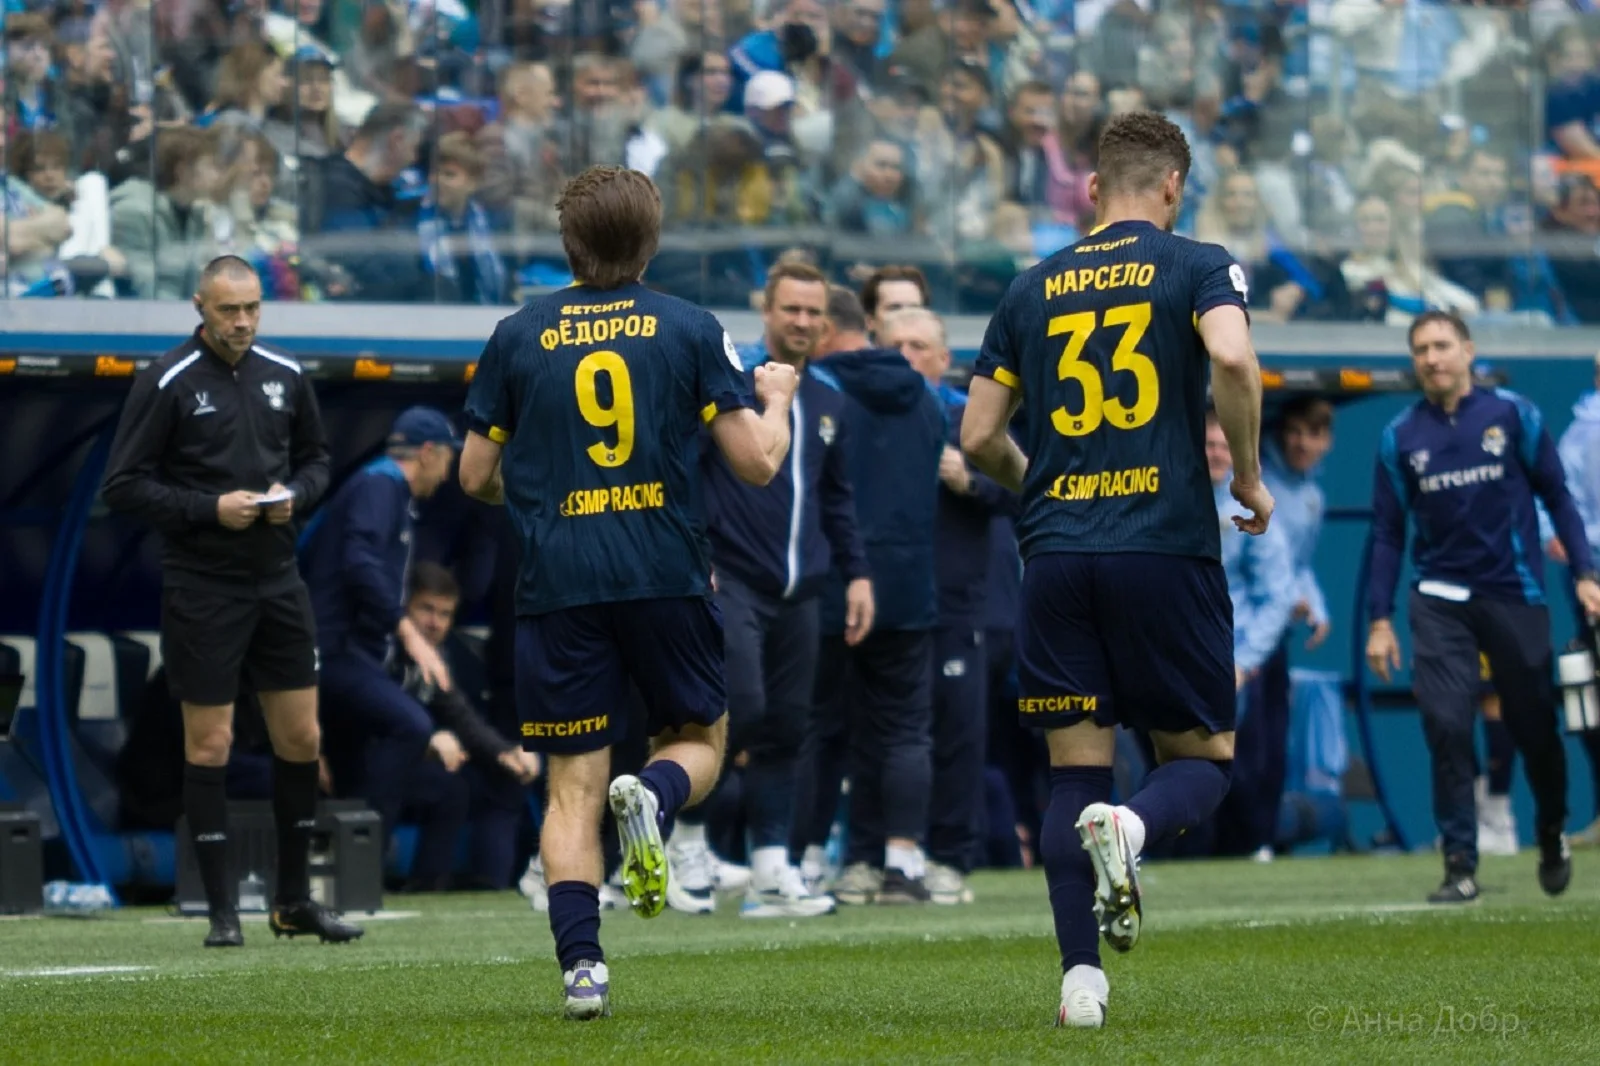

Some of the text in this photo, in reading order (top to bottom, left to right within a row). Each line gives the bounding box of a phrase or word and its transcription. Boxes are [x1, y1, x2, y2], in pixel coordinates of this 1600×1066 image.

[1045, 263, 1155, 300] МАРСЕЛО
[560, 299, 635, 315] БЕТСИТИ
[540, 315, 657, 350] ФЁДОРОВ
[1047, 301, 1160, 437] 33
[575, 350, 635, 468] 9
[1064, 466, 1160, 500] SMP RACING
[575, 488, 609, 514] SMP
[521, 714, 609, 737] БЕТСИТИ
